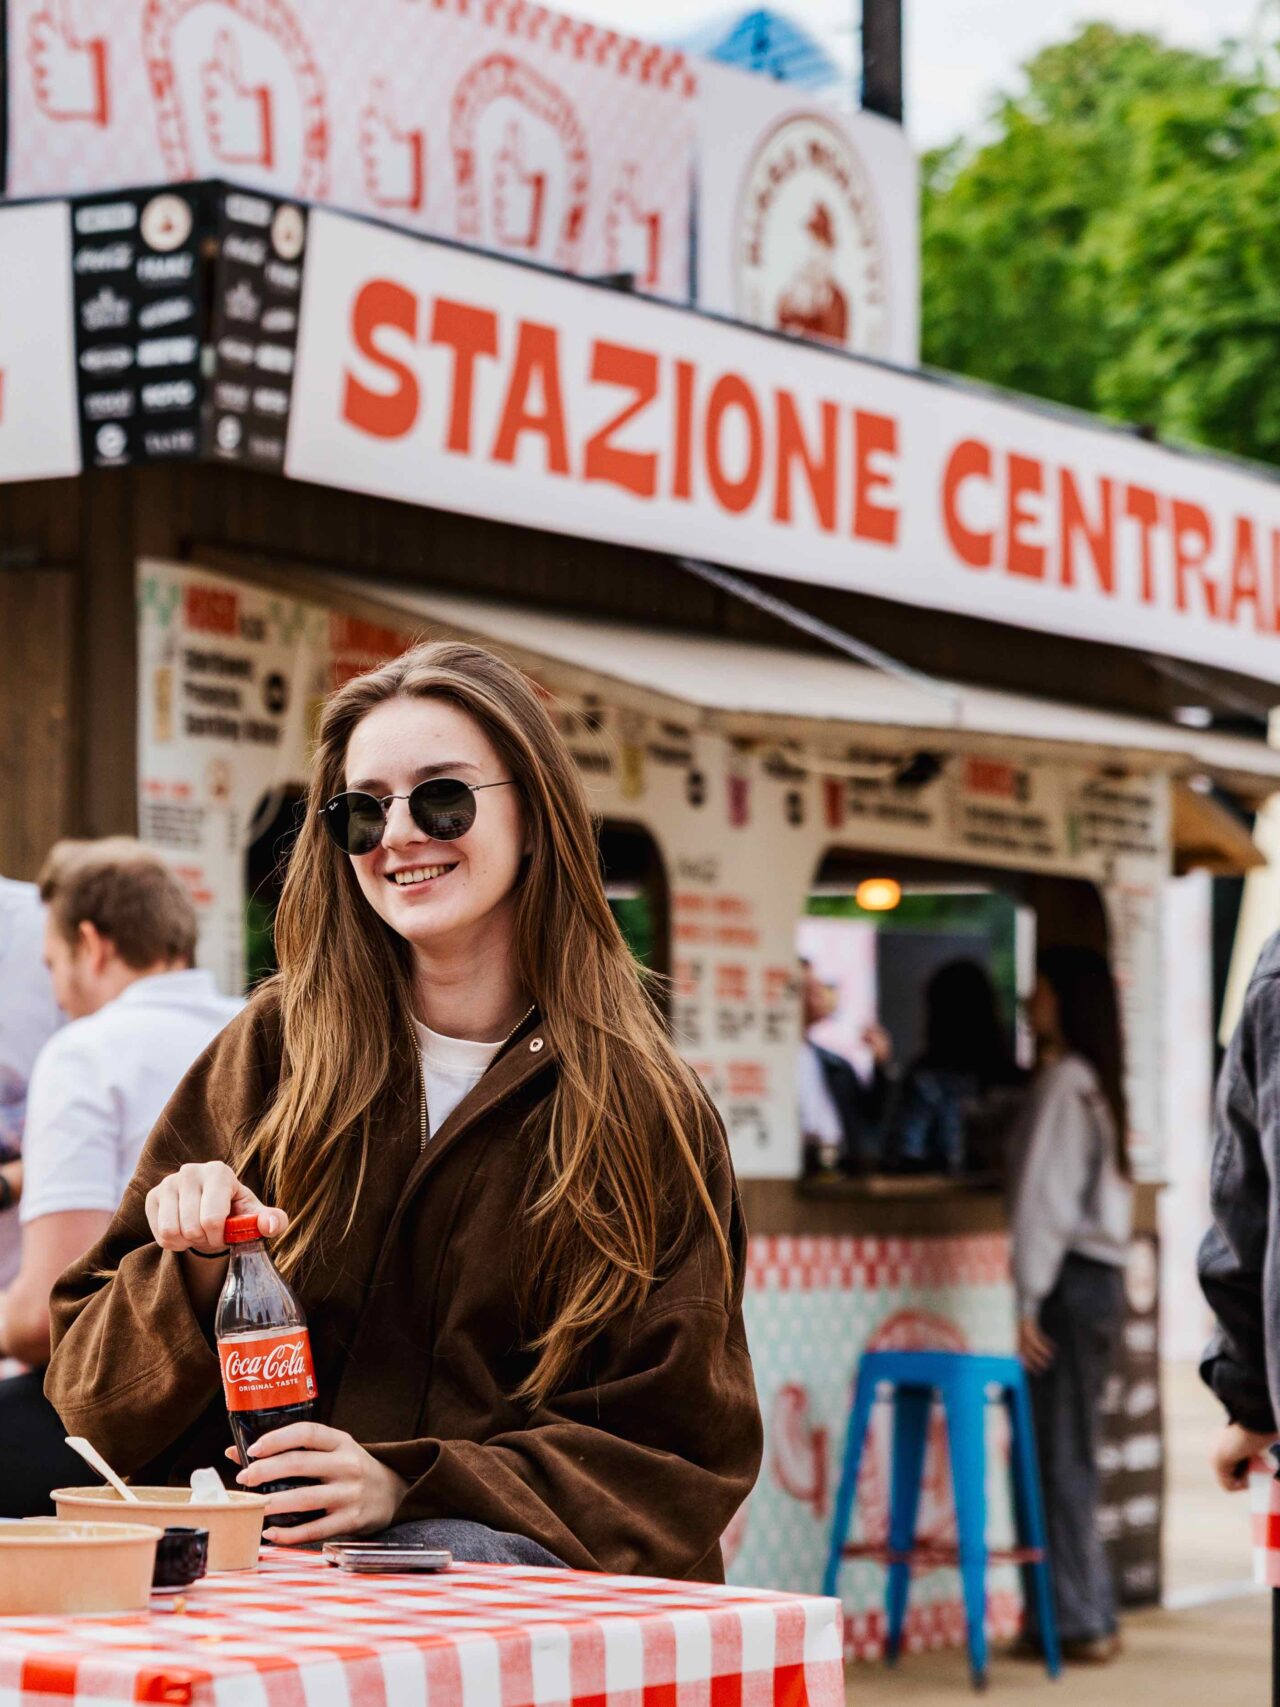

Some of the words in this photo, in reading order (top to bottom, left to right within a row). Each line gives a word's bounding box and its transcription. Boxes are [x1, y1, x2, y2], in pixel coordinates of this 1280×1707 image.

[341, 278, 899, 548] STAZIONE
[225, 1340, 305, 1384] Coca-Cola
[239, 1383, 274, 1392] ORIGINAL
[276, 1378, 299, 1388] TASTE
